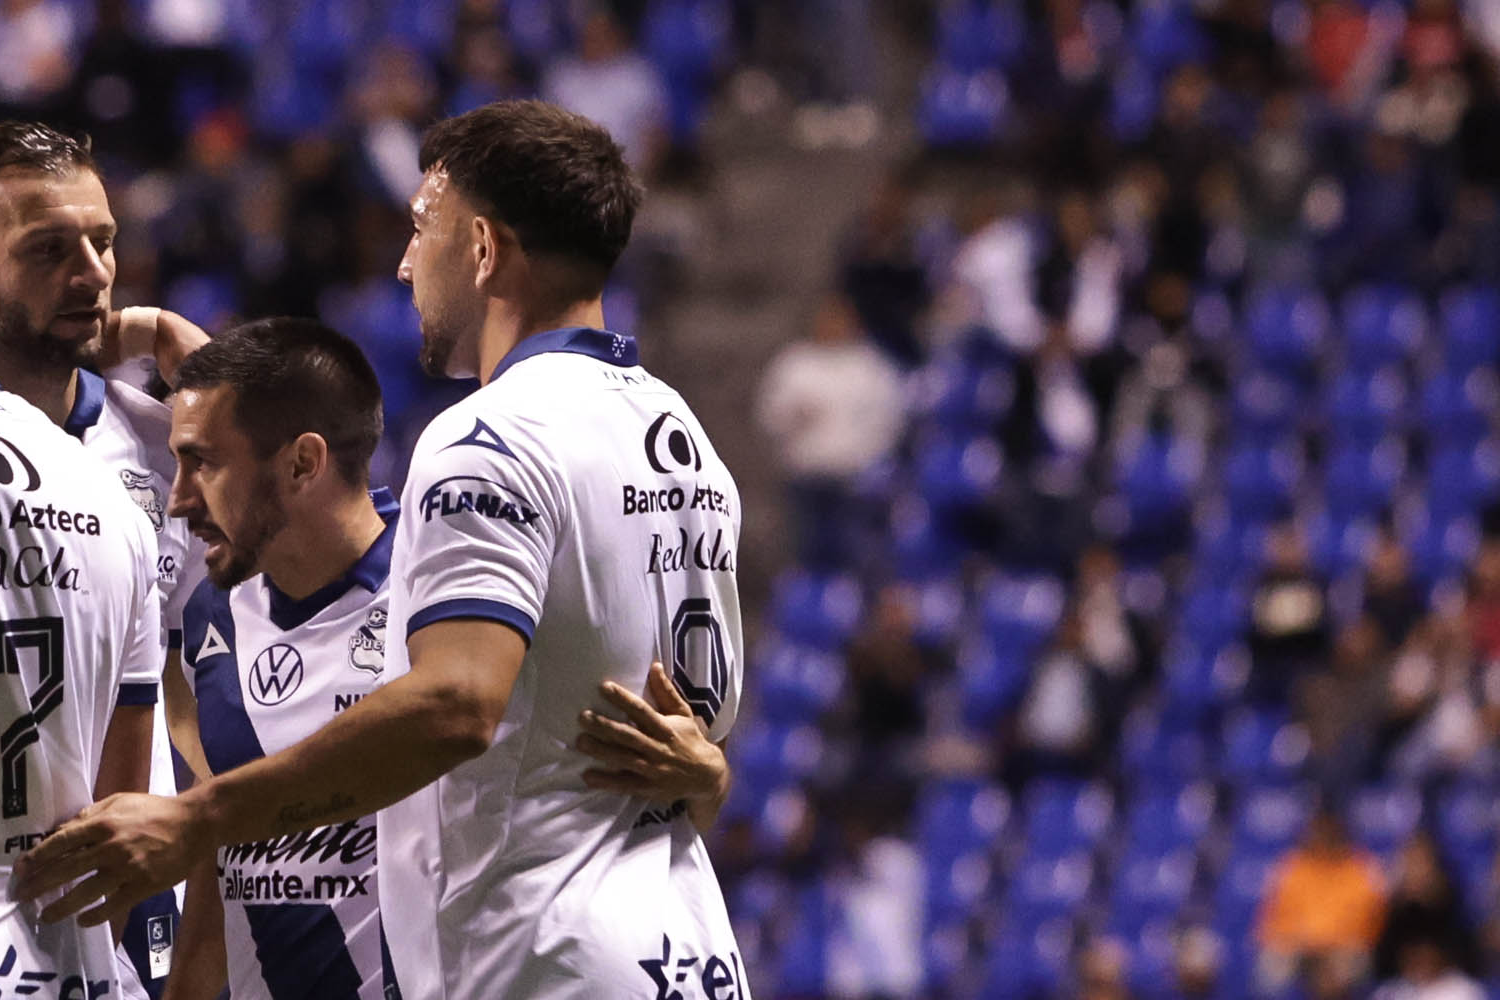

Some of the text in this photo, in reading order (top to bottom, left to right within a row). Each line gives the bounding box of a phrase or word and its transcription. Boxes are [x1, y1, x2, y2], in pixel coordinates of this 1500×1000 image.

[425, 488, 540, 527] FLANAX
[622, 484, 685, 516] Banco
[8, 499, 101, 537] Azteca
[218, 868, 371, 901] aliente.mx
